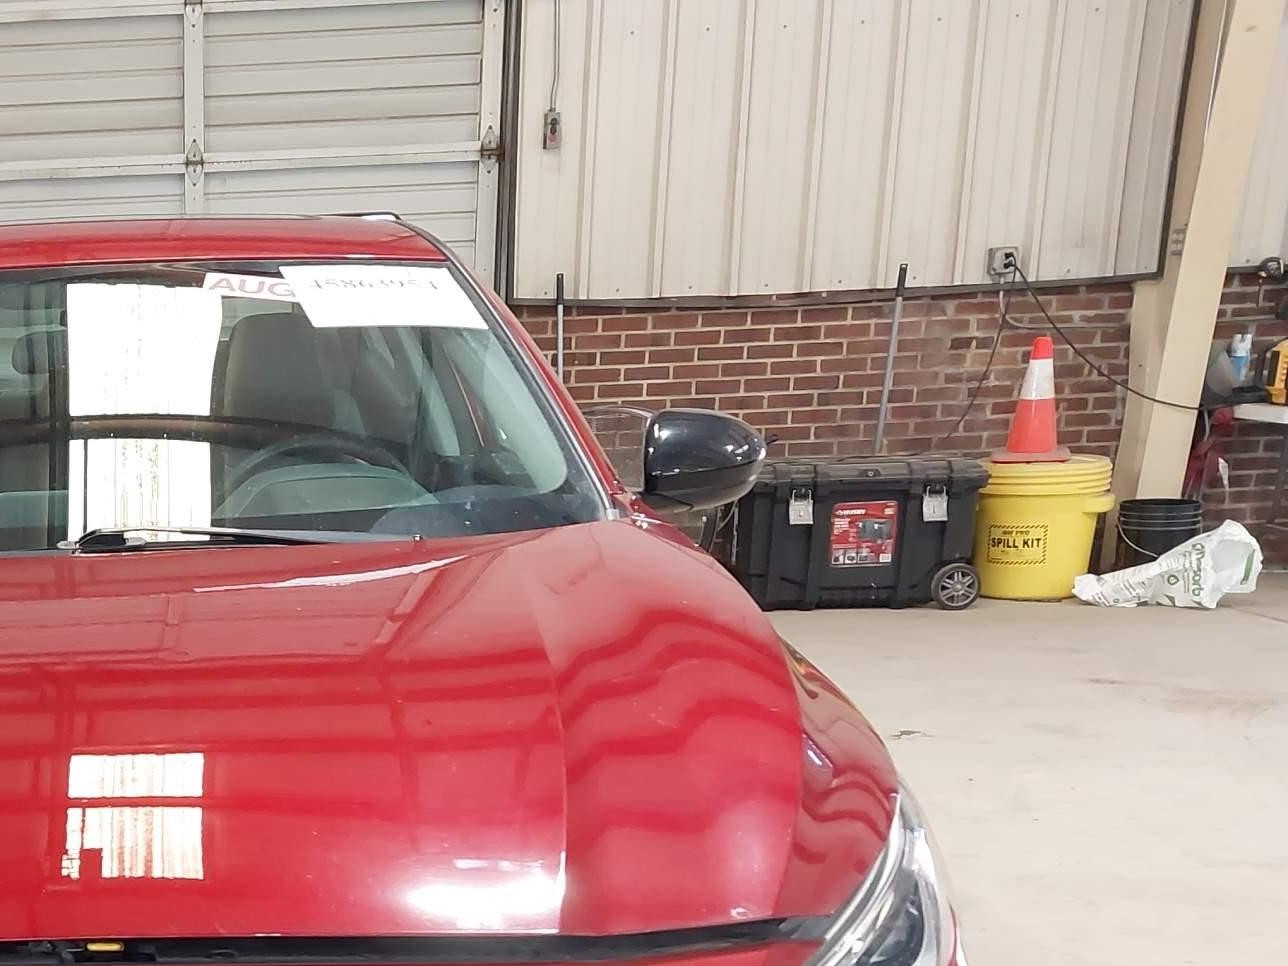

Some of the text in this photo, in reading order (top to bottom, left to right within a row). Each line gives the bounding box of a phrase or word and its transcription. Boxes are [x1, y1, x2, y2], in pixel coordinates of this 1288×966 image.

[209, 277, 297, 298] AUG
[991, 537, 1042, 548] SPILL KIT
